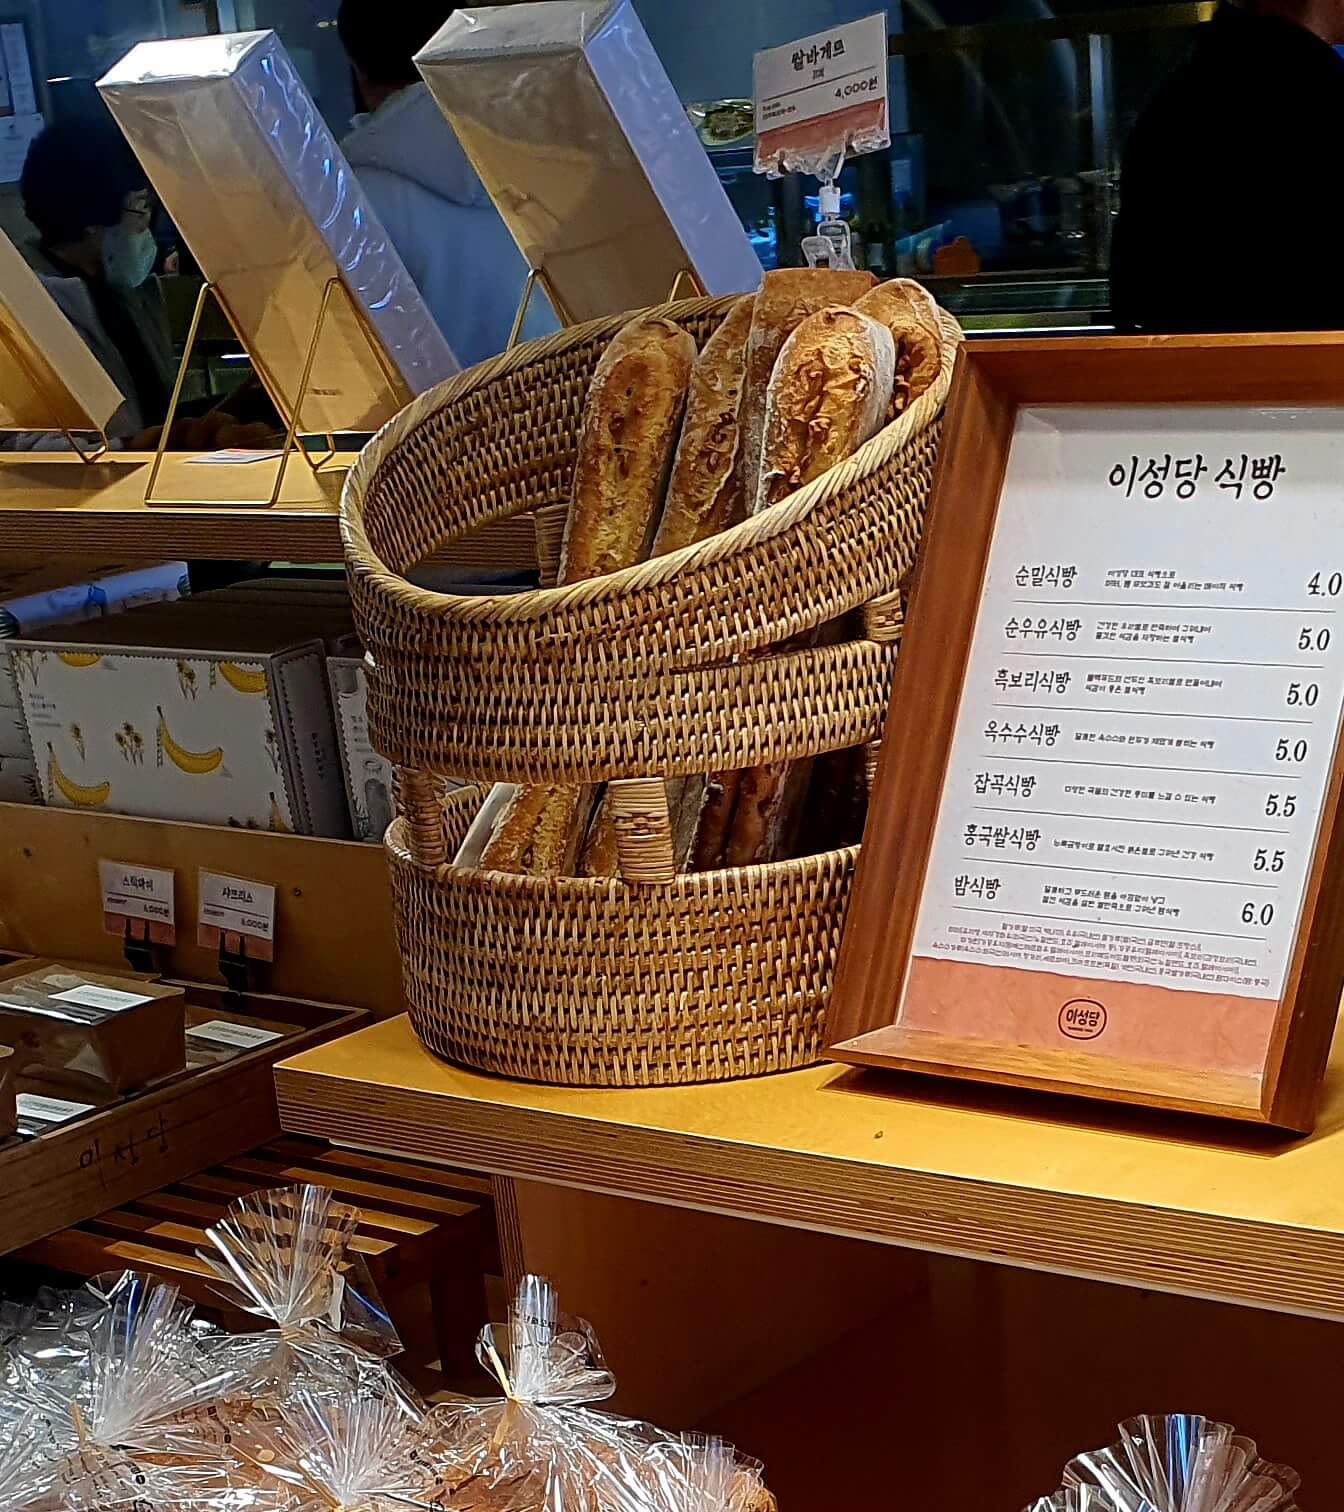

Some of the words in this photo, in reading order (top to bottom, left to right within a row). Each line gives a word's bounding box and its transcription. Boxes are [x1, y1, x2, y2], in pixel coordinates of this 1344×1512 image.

[834, 76, 878, 100] 4,000원
[1107, 453, 1208, 501] 이성당
[1213, 453, 1286, 501] 식빵
[1014, 563, 1079, 590] 순밀식빵
[1307, 570, 1343, 598] 4.0
[1004, 615, 1083, 642] 순우유식빵
[1297, 626, 1332, 652] 5.0
[994, 667, 1072, 695] 흑보리식빵
[1286, 681, 1320, 708] 5.0
[983, 719, 1061, 747] 옥수수식빵
[1274, 737, 1308, 764] 5.0
[973, 772, 1038, 798] 잡곡식빵
[1264, 792, 1298, 819] 5.5
[962, 824, 1042, 852] 홍국쌀식빵
[1252, 847, 1286, 874] 5.5
[952, 875, 1002, 901] 밤식빵
[1241, 901, 1275, 928] 6.0
[1066, 1008, 1101, 1027] 이성당
